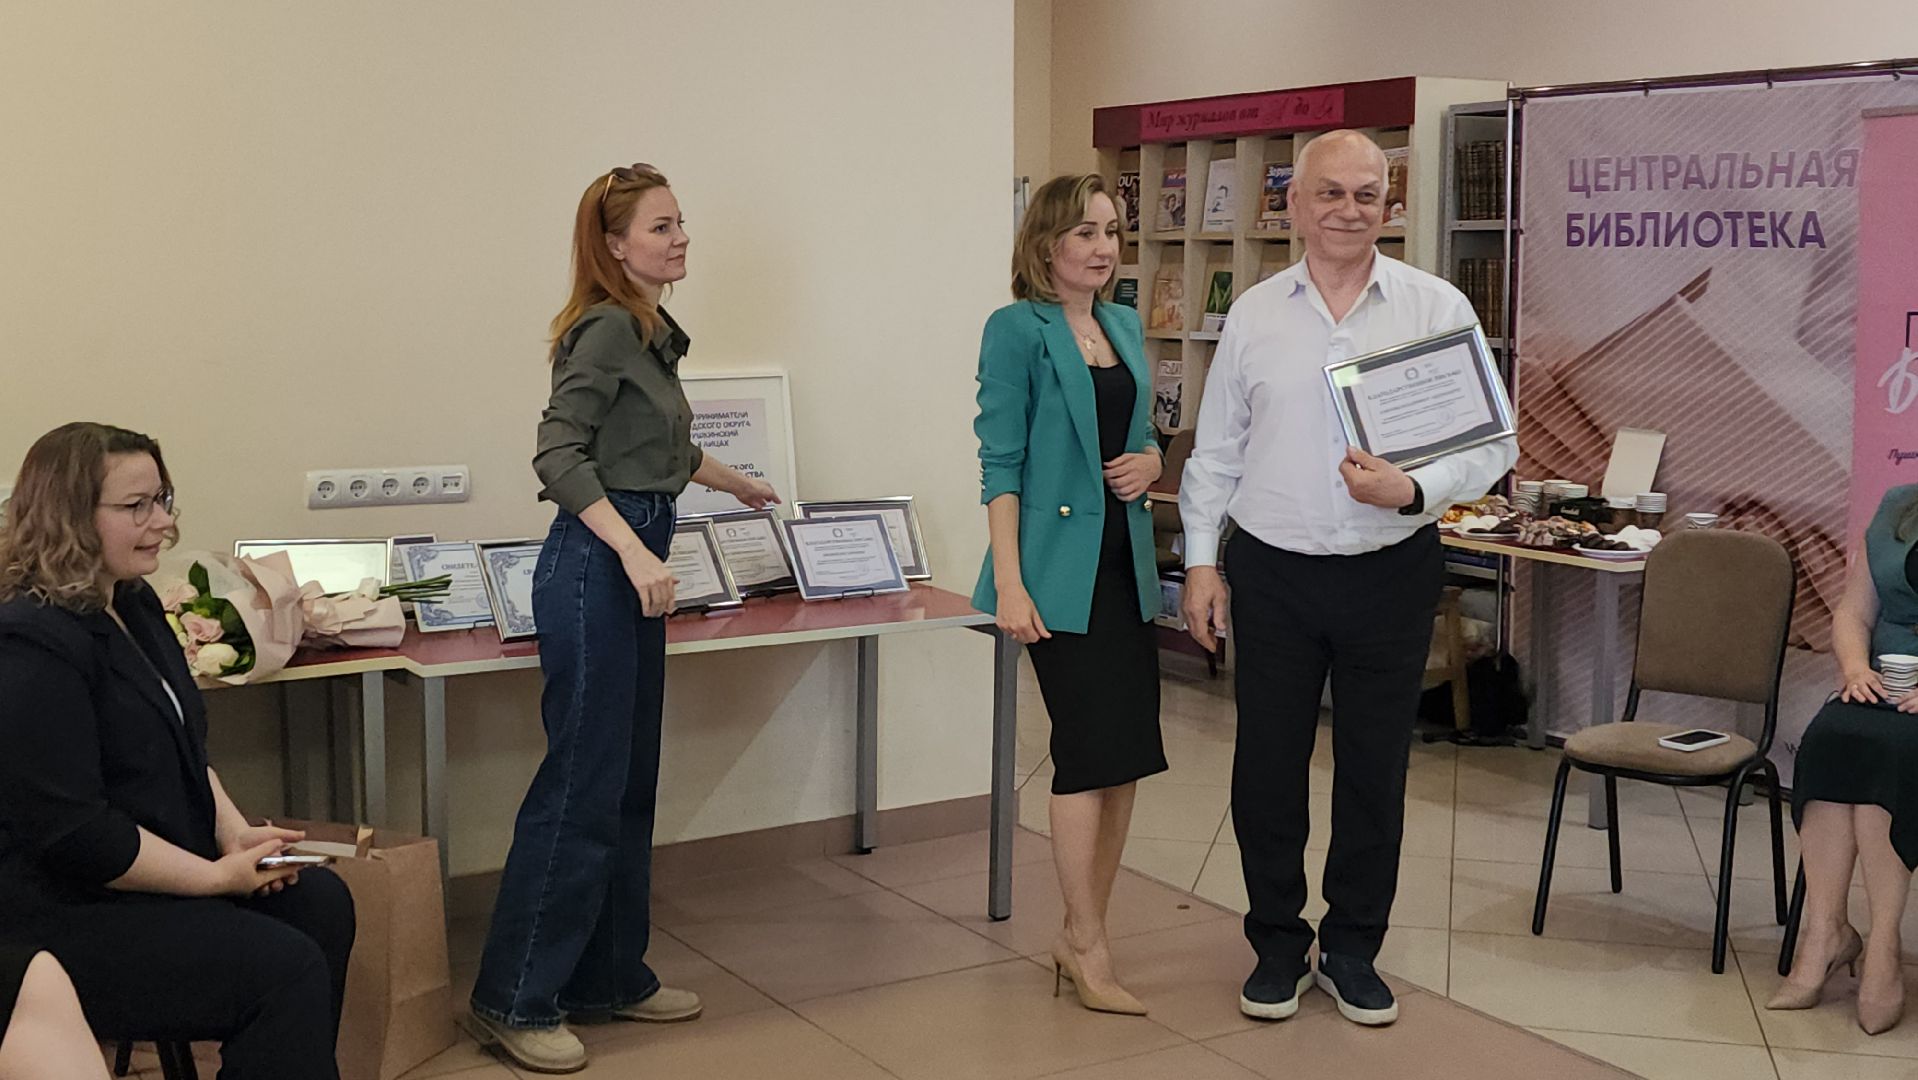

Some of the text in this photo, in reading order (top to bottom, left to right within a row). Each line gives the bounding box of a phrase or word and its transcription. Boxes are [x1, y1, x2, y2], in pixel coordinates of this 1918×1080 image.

[1147, 110, 1174, 133] Мир
[1568, 149, 1860, 199] ЦЕНТРАЛЬНАЯ
[1566, 211, 1826, 248] БИБЛИОТЕКА
